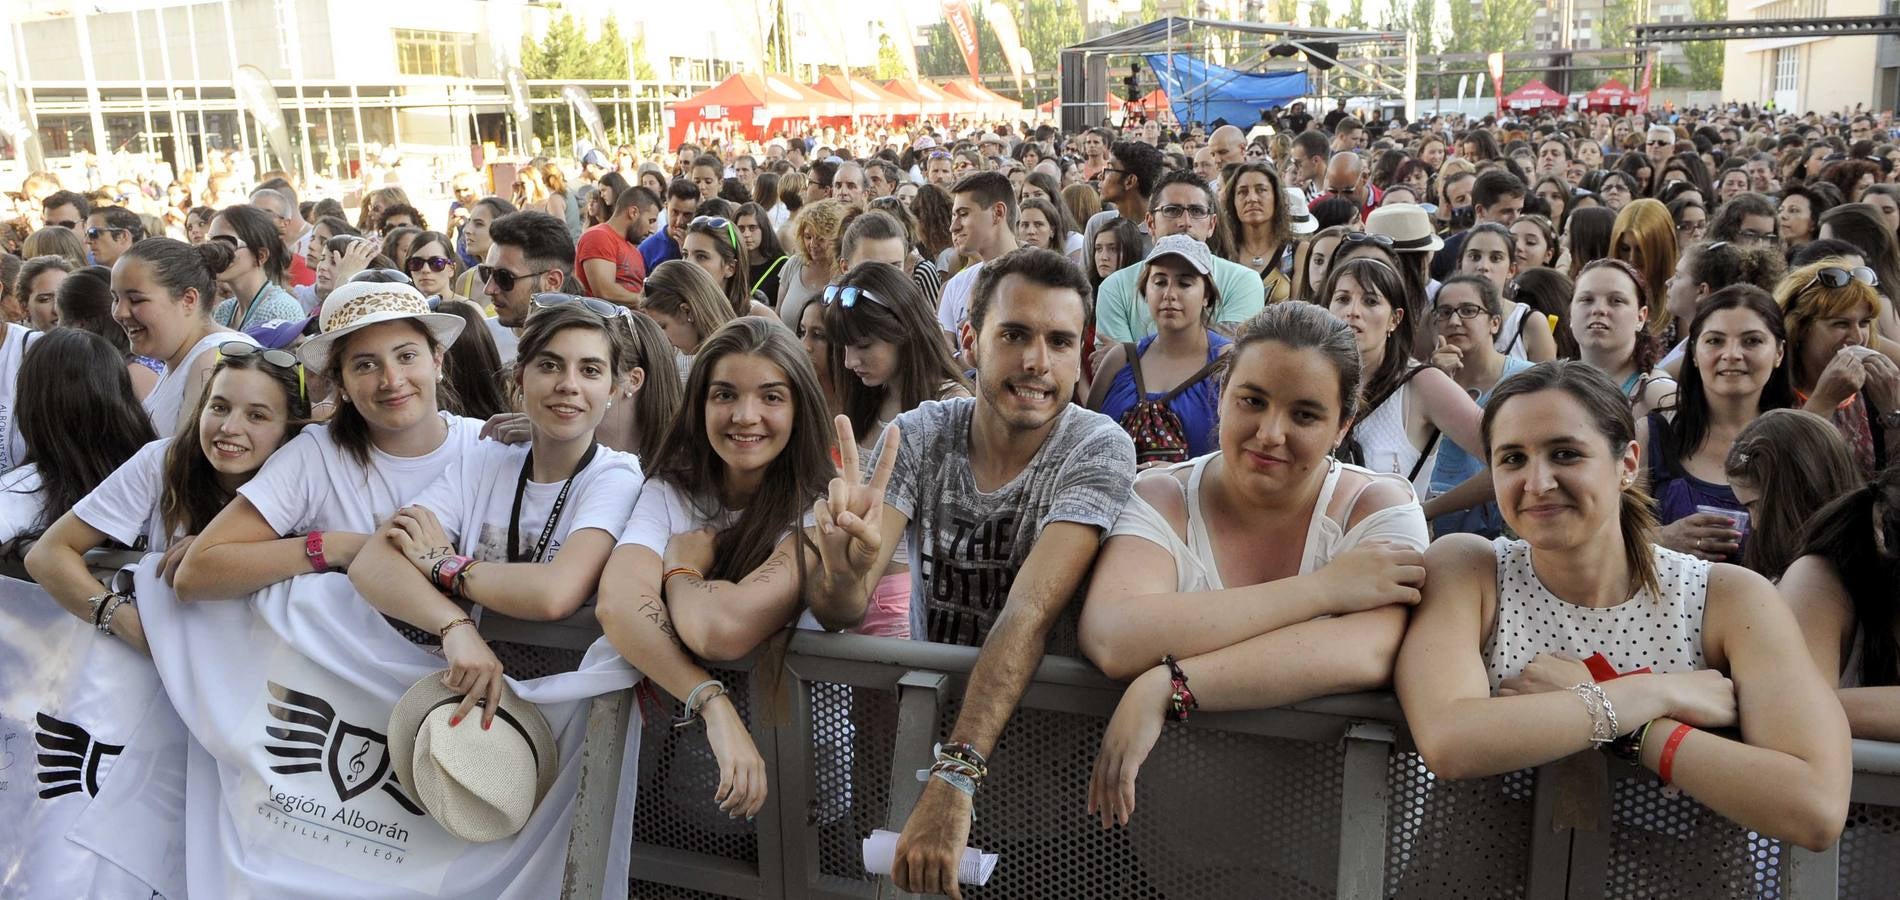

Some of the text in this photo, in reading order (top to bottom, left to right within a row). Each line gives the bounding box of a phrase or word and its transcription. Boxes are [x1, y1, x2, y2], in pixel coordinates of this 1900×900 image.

[950, 517, 1014, 561] THE
[257, 807, 404, 864] CASTILLA Y LEÓN
[269, 784, 409, 843] Legión Alborán
